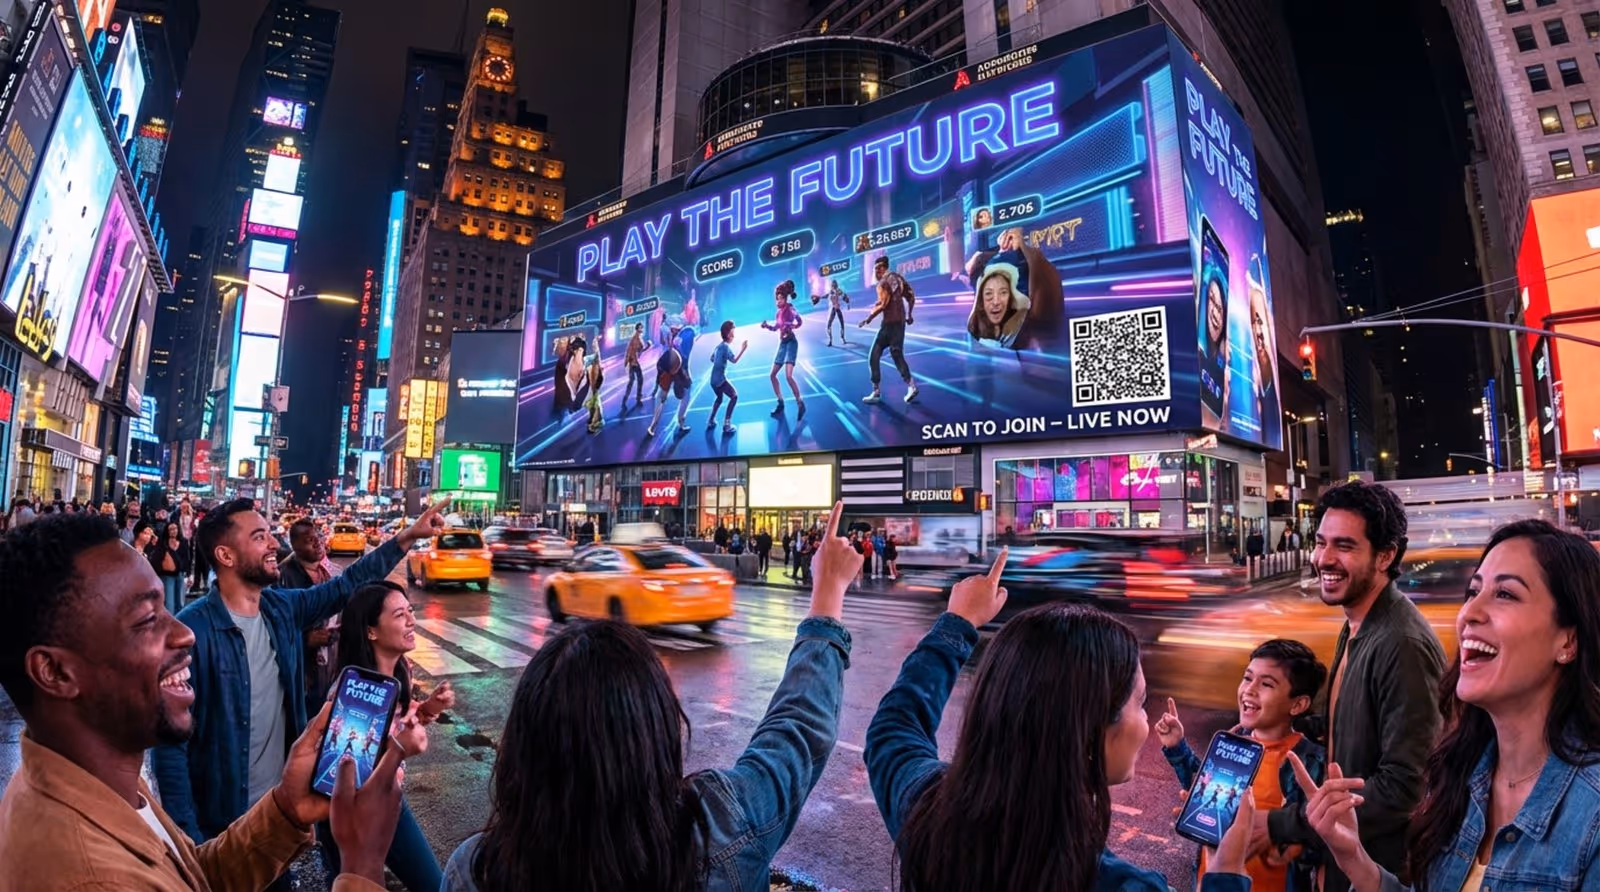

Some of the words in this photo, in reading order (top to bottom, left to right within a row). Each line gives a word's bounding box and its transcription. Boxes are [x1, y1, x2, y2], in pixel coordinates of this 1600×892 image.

[1184, 76, 1231, 155] PLAY
[576, 212, 672, 284] PLAY
[680, 176, 775, 247] THE
[790, 81, 1059, 215] FUTURE
[1187, 119, 1259, 221] FUTURE
[701, 257, 734, 276] SCORE
[921, 423, 968, 440] SCAN
[972, 420, 997, 437] TO
[1001, 416, 1046, 435] JOIN
[1067, 411, 1112, 430] LIVE
[1116, 406, 1171, 427] NOW
